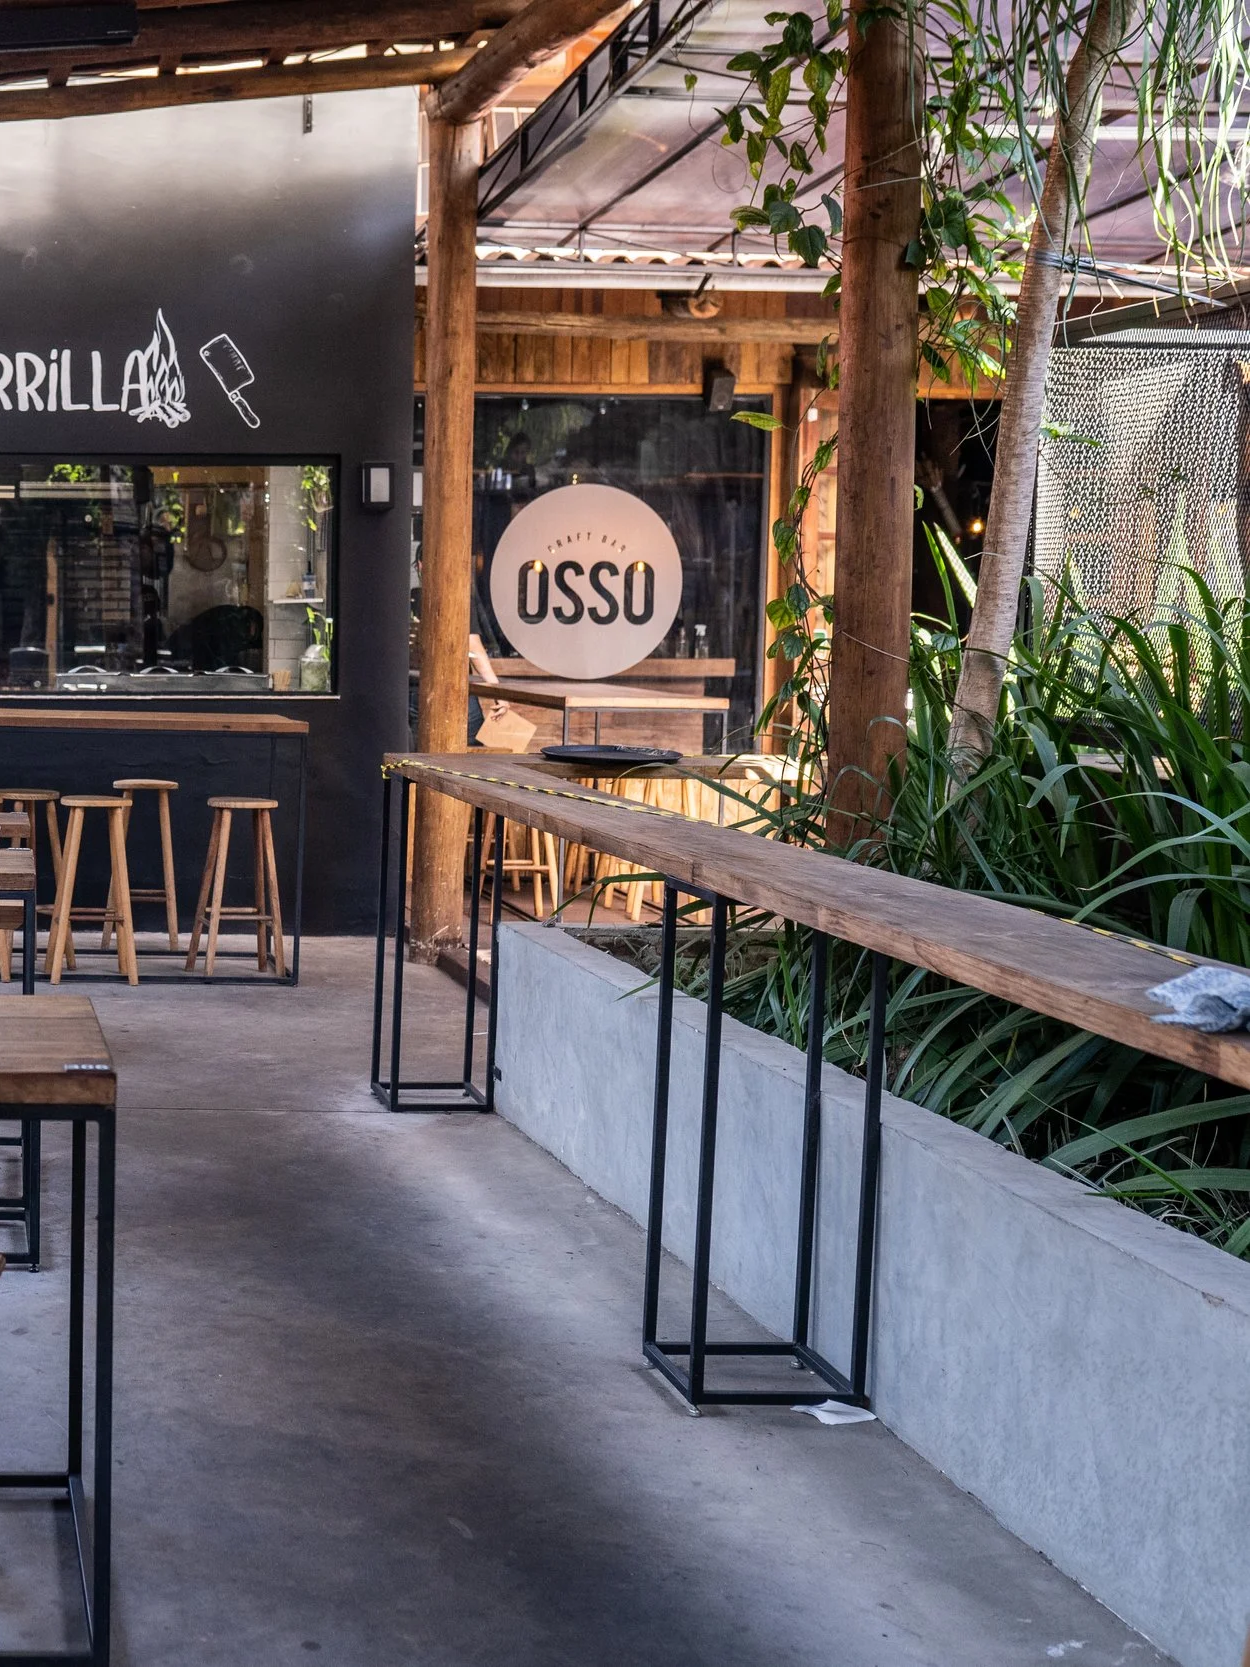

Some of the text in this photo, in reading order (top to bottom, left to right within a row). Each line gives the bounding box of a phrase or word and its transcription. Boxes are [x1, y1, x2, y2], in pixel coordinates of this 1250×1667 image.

[547, 532, 626, 552] CRAFT BAR
[517, 559, 655, 625] OSSO
